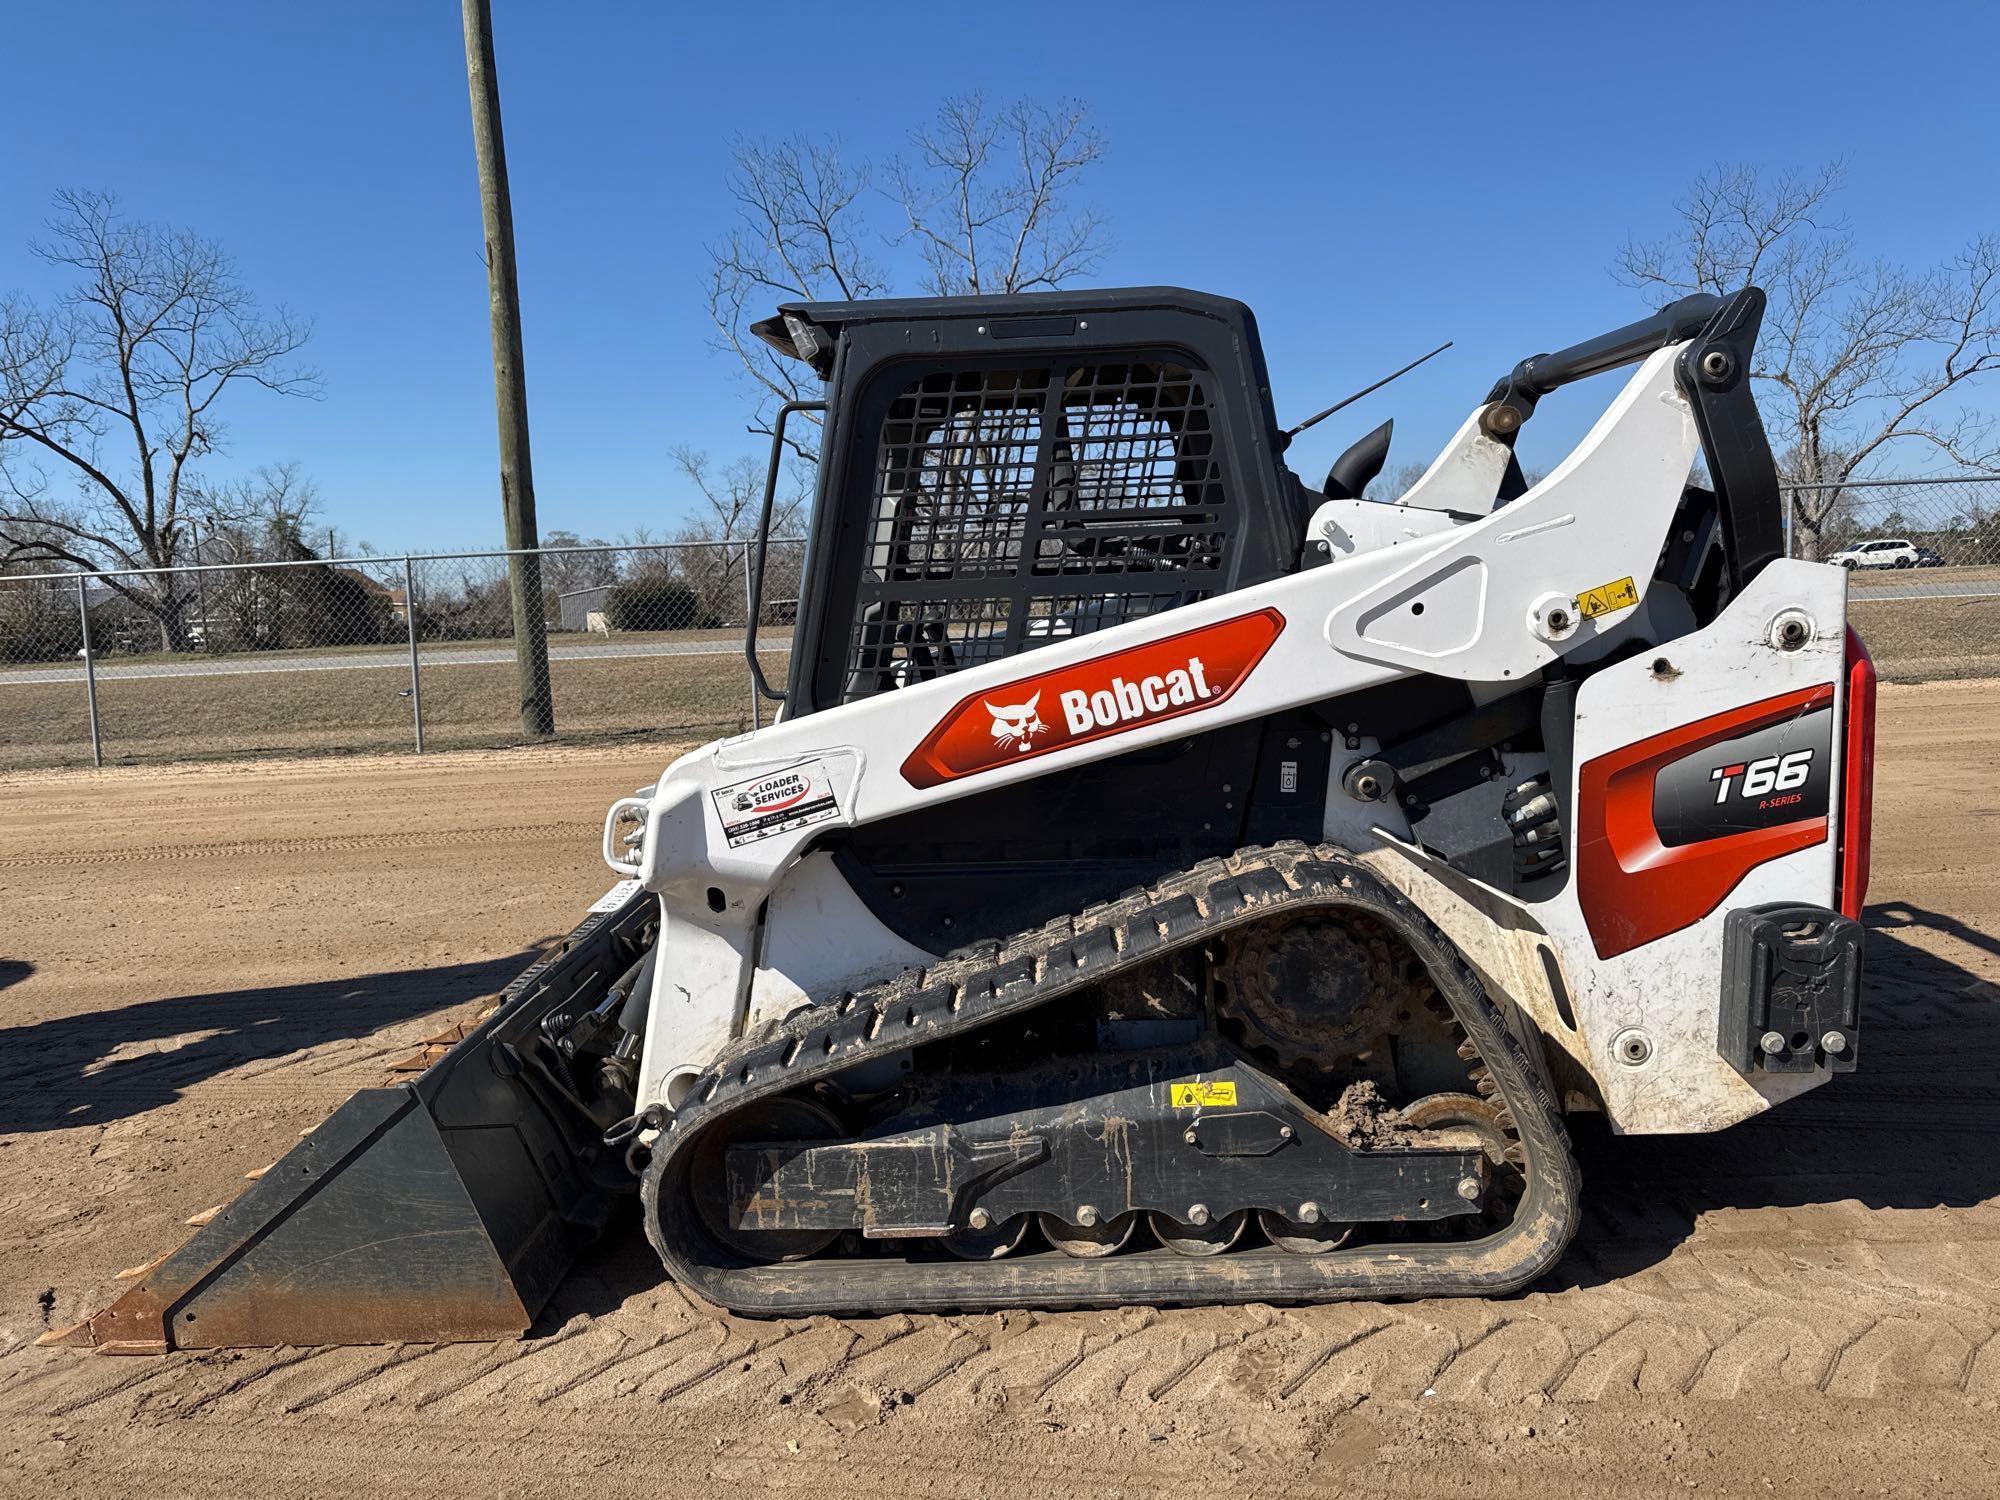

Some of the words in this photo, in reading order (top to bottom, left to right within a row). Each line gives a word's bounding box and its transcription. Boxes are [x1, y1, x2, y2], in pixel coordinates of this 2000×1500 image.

[1059, 656, 1212, 736] Bobcat
[759, 774, 800, 794] LOADER
[1710, 749, 1814, 805] T66
[755, 784, 805, 806] SERVICES
[1759, 793, 1802, 810] R-SERIES
